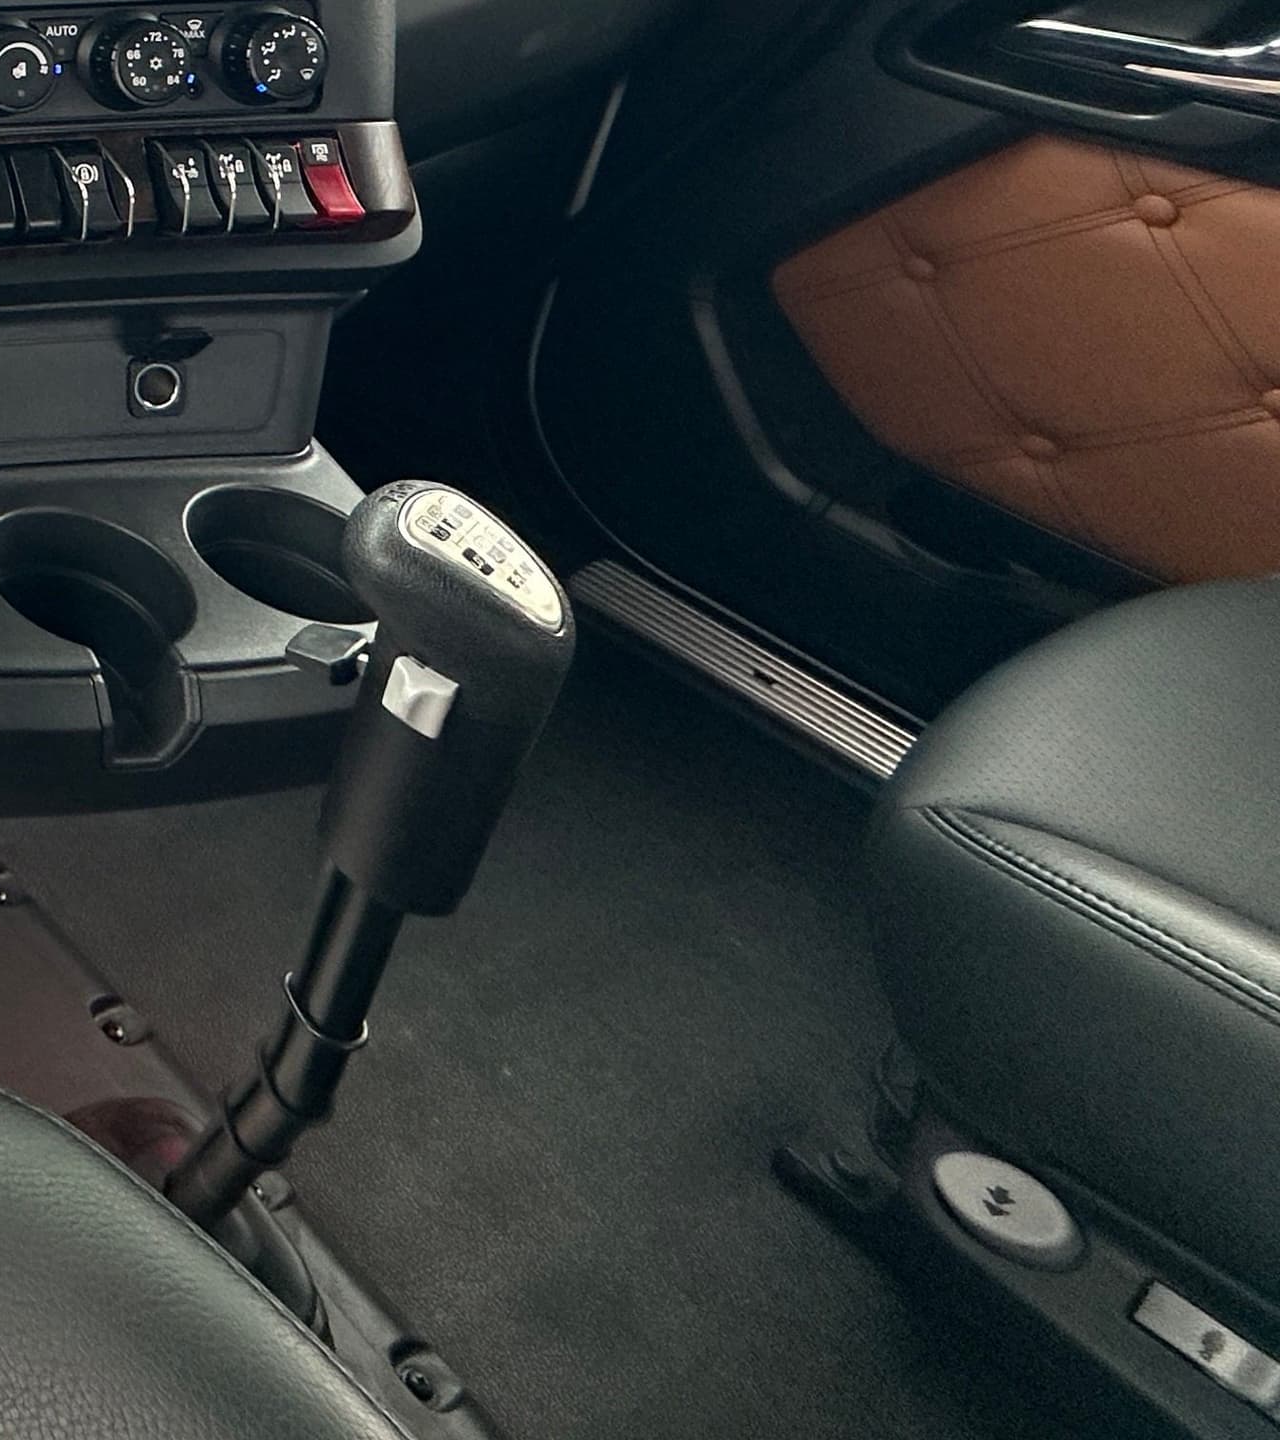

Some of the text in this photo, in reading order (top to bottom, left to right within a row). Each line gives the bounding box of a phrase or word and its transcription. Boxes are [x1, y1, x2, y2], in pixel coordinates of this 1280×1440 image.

[46, 25, 78, 37] AUTO
[149, 32, 162, 42] 72
[126, 49, 140, 59] 66
[172, 48, 185, 58] 78
[132, 76, 147, 86] 60
[167, 75, 180, 85] 84
